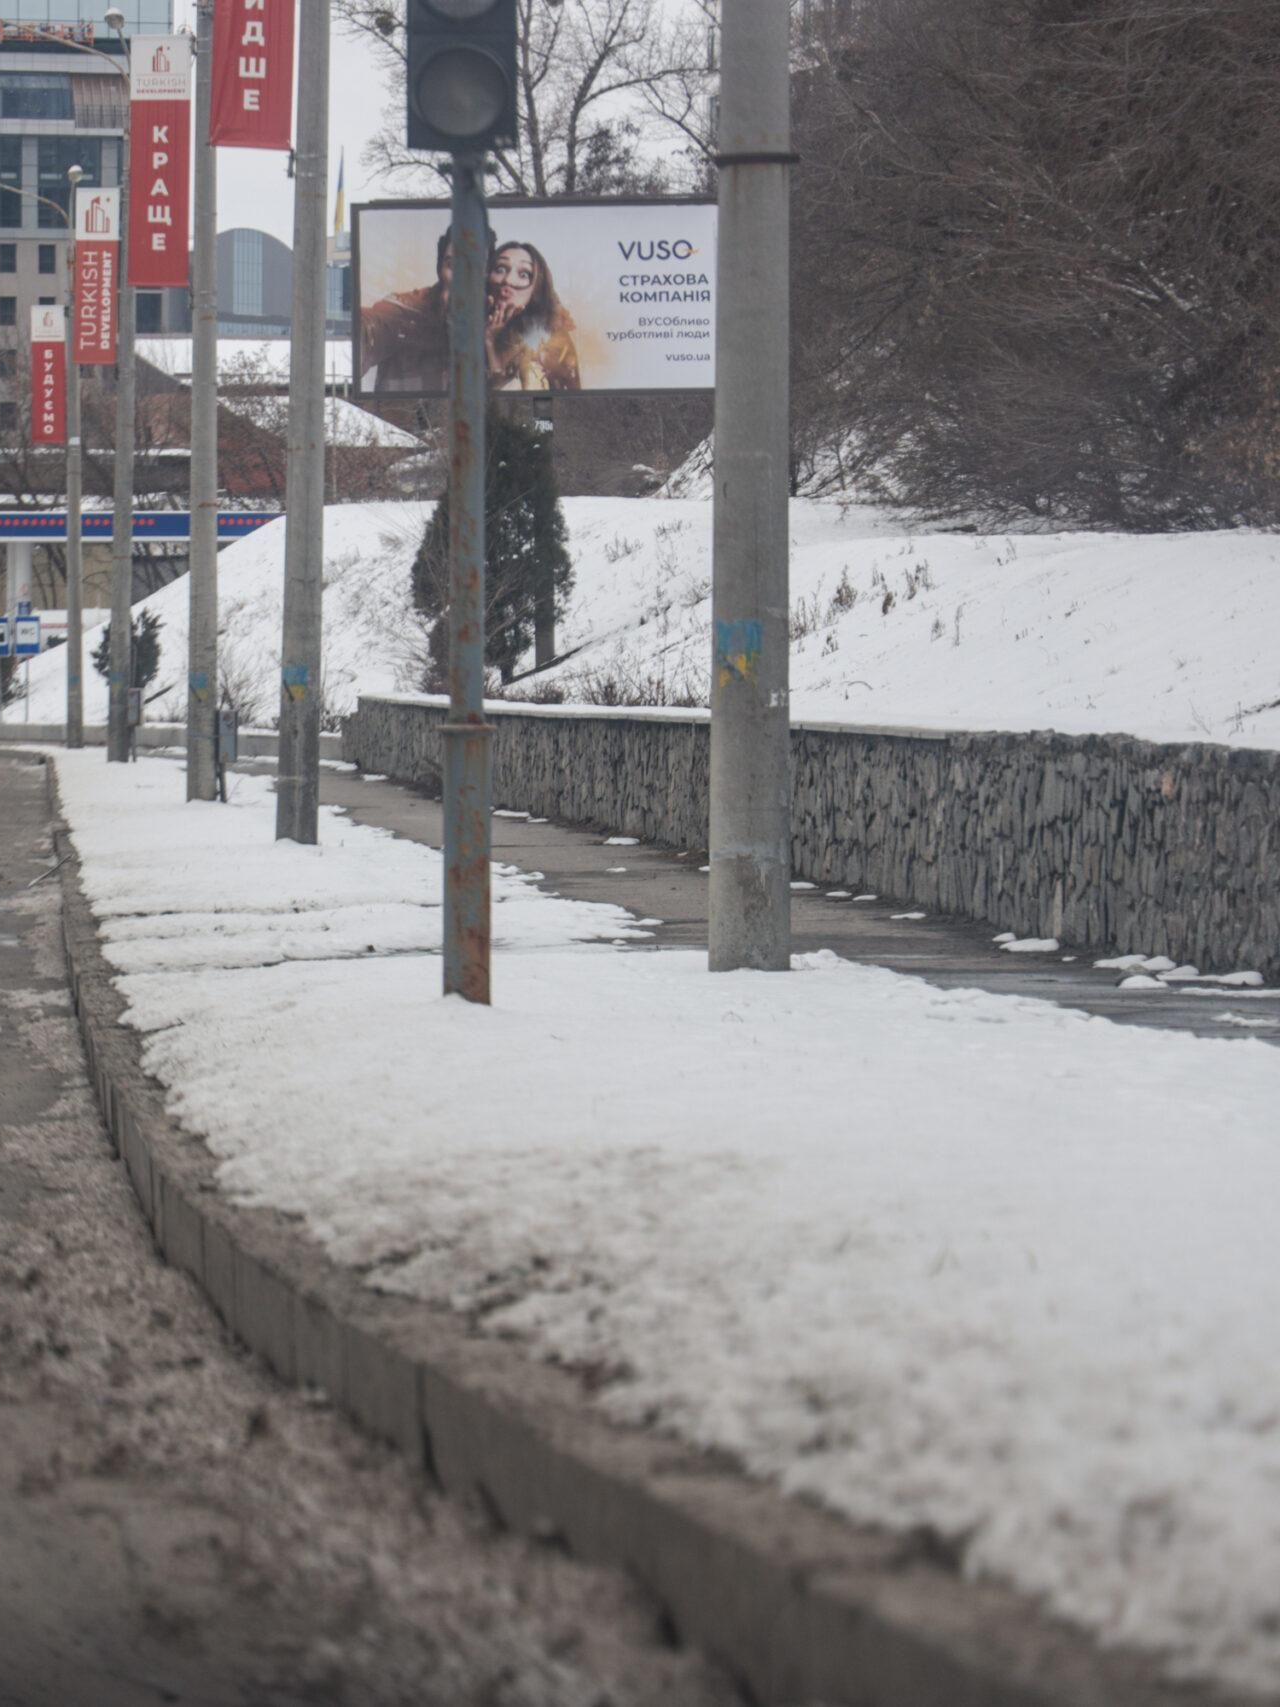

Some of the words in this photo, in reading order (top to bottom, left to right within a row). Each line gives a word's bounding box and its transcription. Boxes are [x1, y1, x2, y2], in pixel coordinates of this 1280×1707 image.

[136, 78, 186, 87] TURKISH
[147, 125, 172, 251] КРАЩЕ
[618, 239, 695, 261] VUSO
[619, 273, 709, 287] СТРАХОВА
[80, 251, 98, 350] TURKISH
[100, 250, 113, 350] DEVELOPMENT
[619, 289, 711, 303] КОМПАНІЯ
[638, 316, 710, 327] ВУСОбливо
[606, 329, 673, 341] турботливі
[676, 330, 710, 340] люди
[665, 353, 711, 361] vuso.ua
[42, 349, 55, 435] БУДУЄМО
